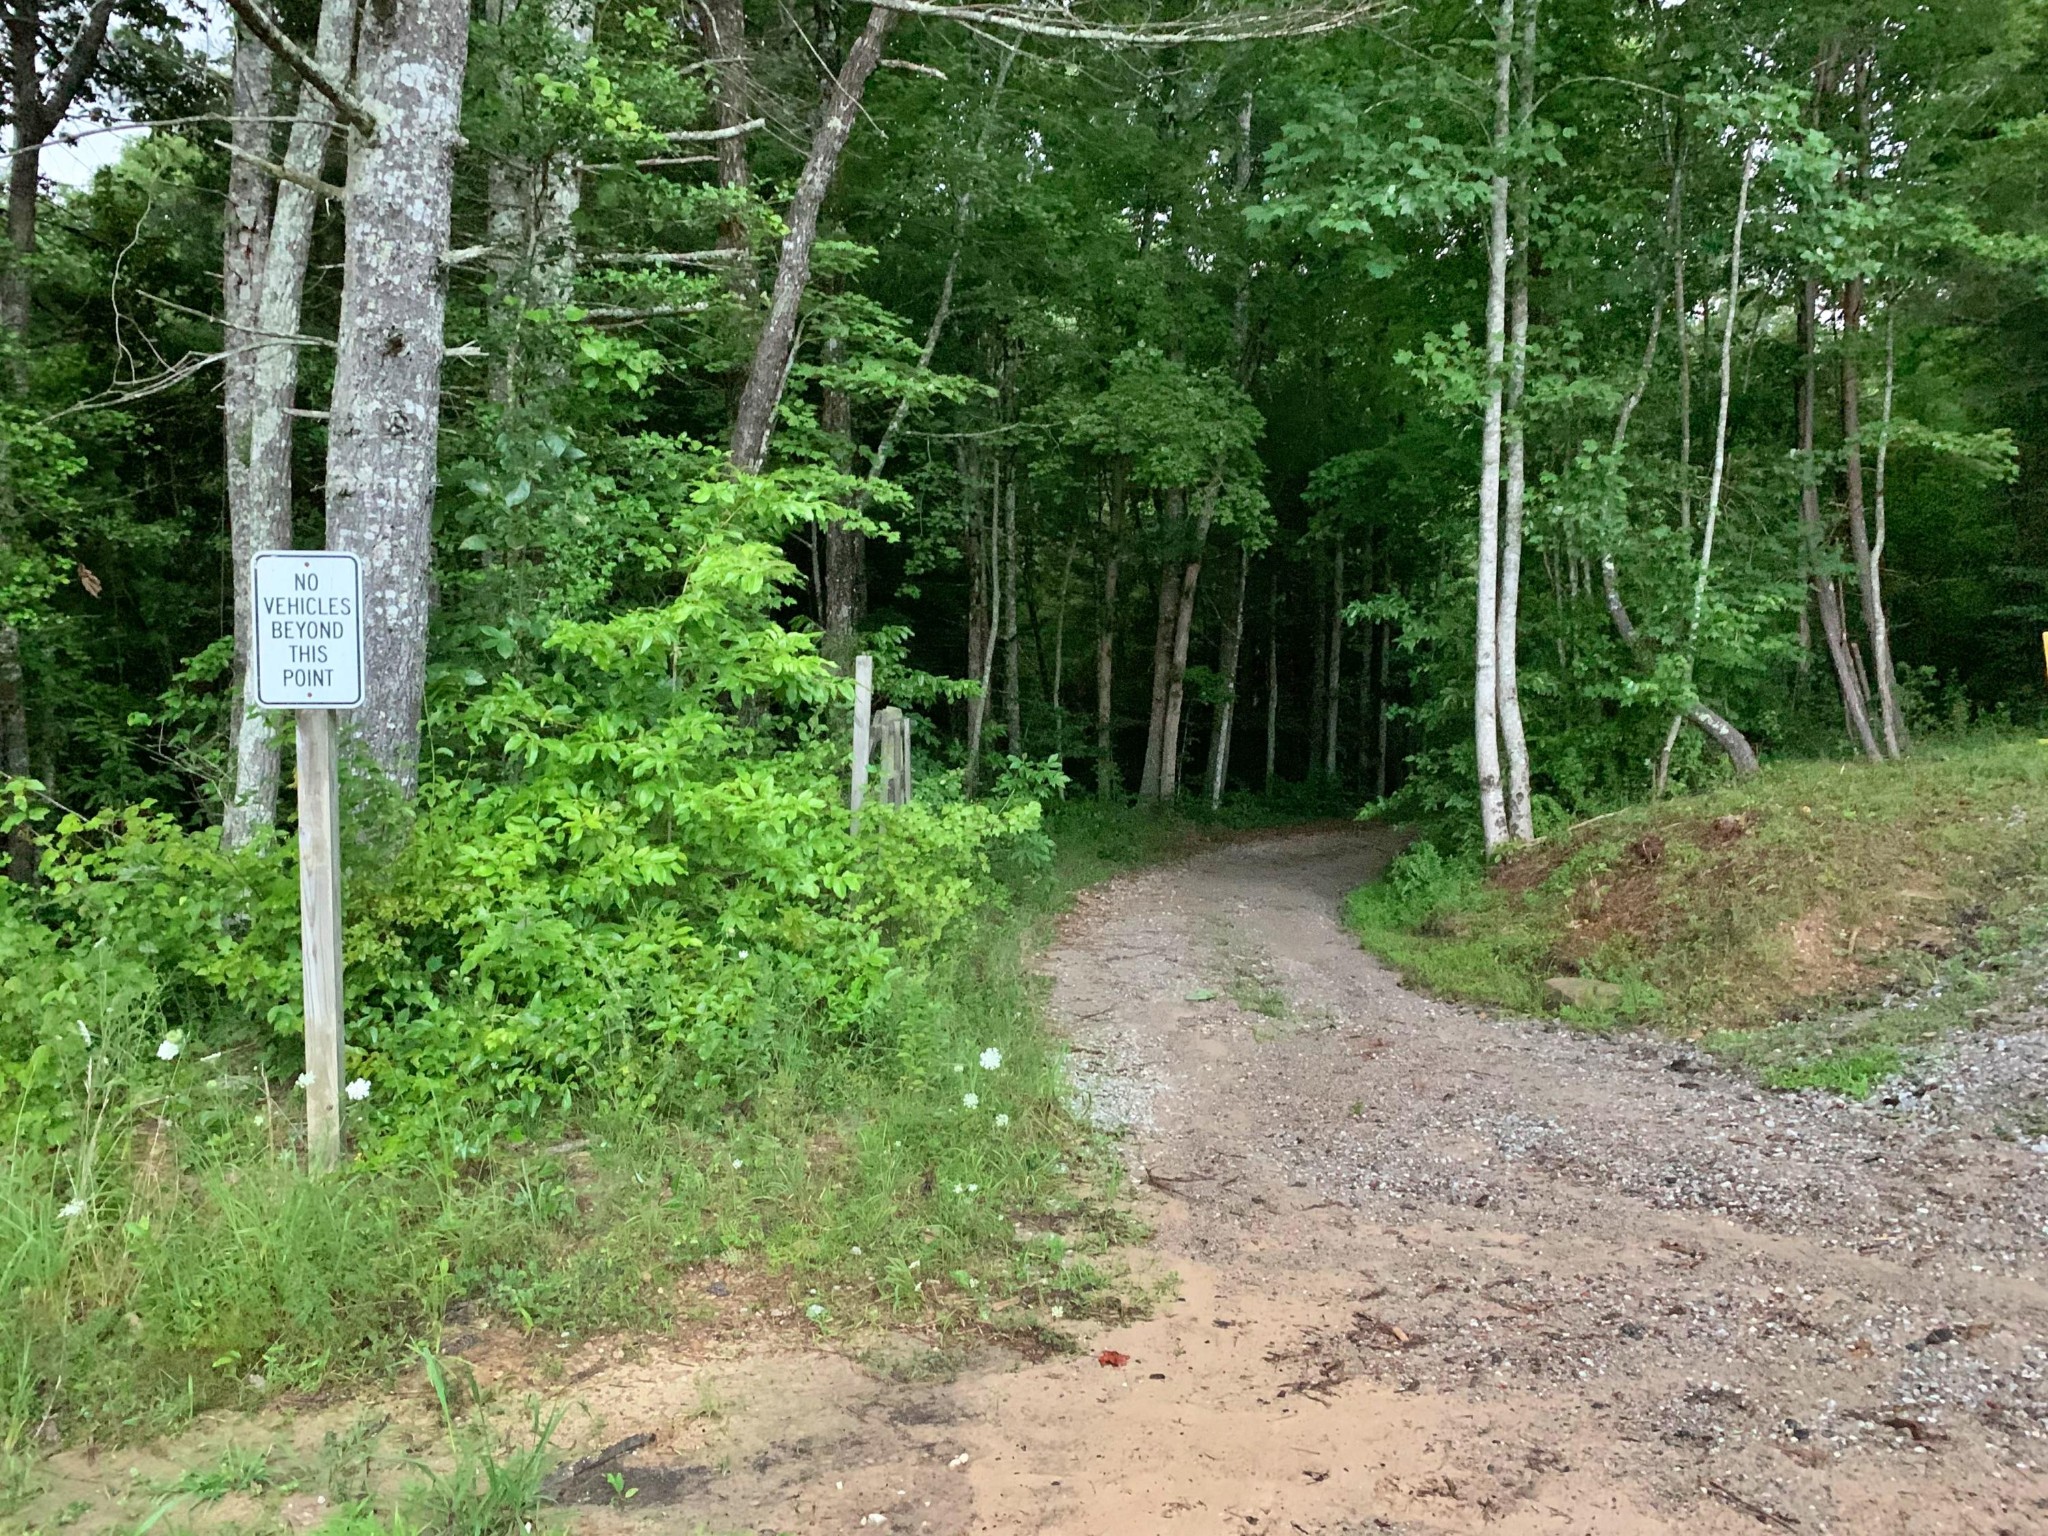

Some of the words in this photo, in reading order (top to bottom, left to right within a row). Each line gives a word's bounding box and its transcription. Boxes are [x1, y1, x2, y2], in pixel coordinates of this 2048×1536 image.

[294, 573, 319, 591] NO
[263, 597, 351, 615] VEHICLES
[272, 621, 344, 639] BEYOND
[288, 645, 328, 663] THIS
[283, 669, 334, 687] POINT
